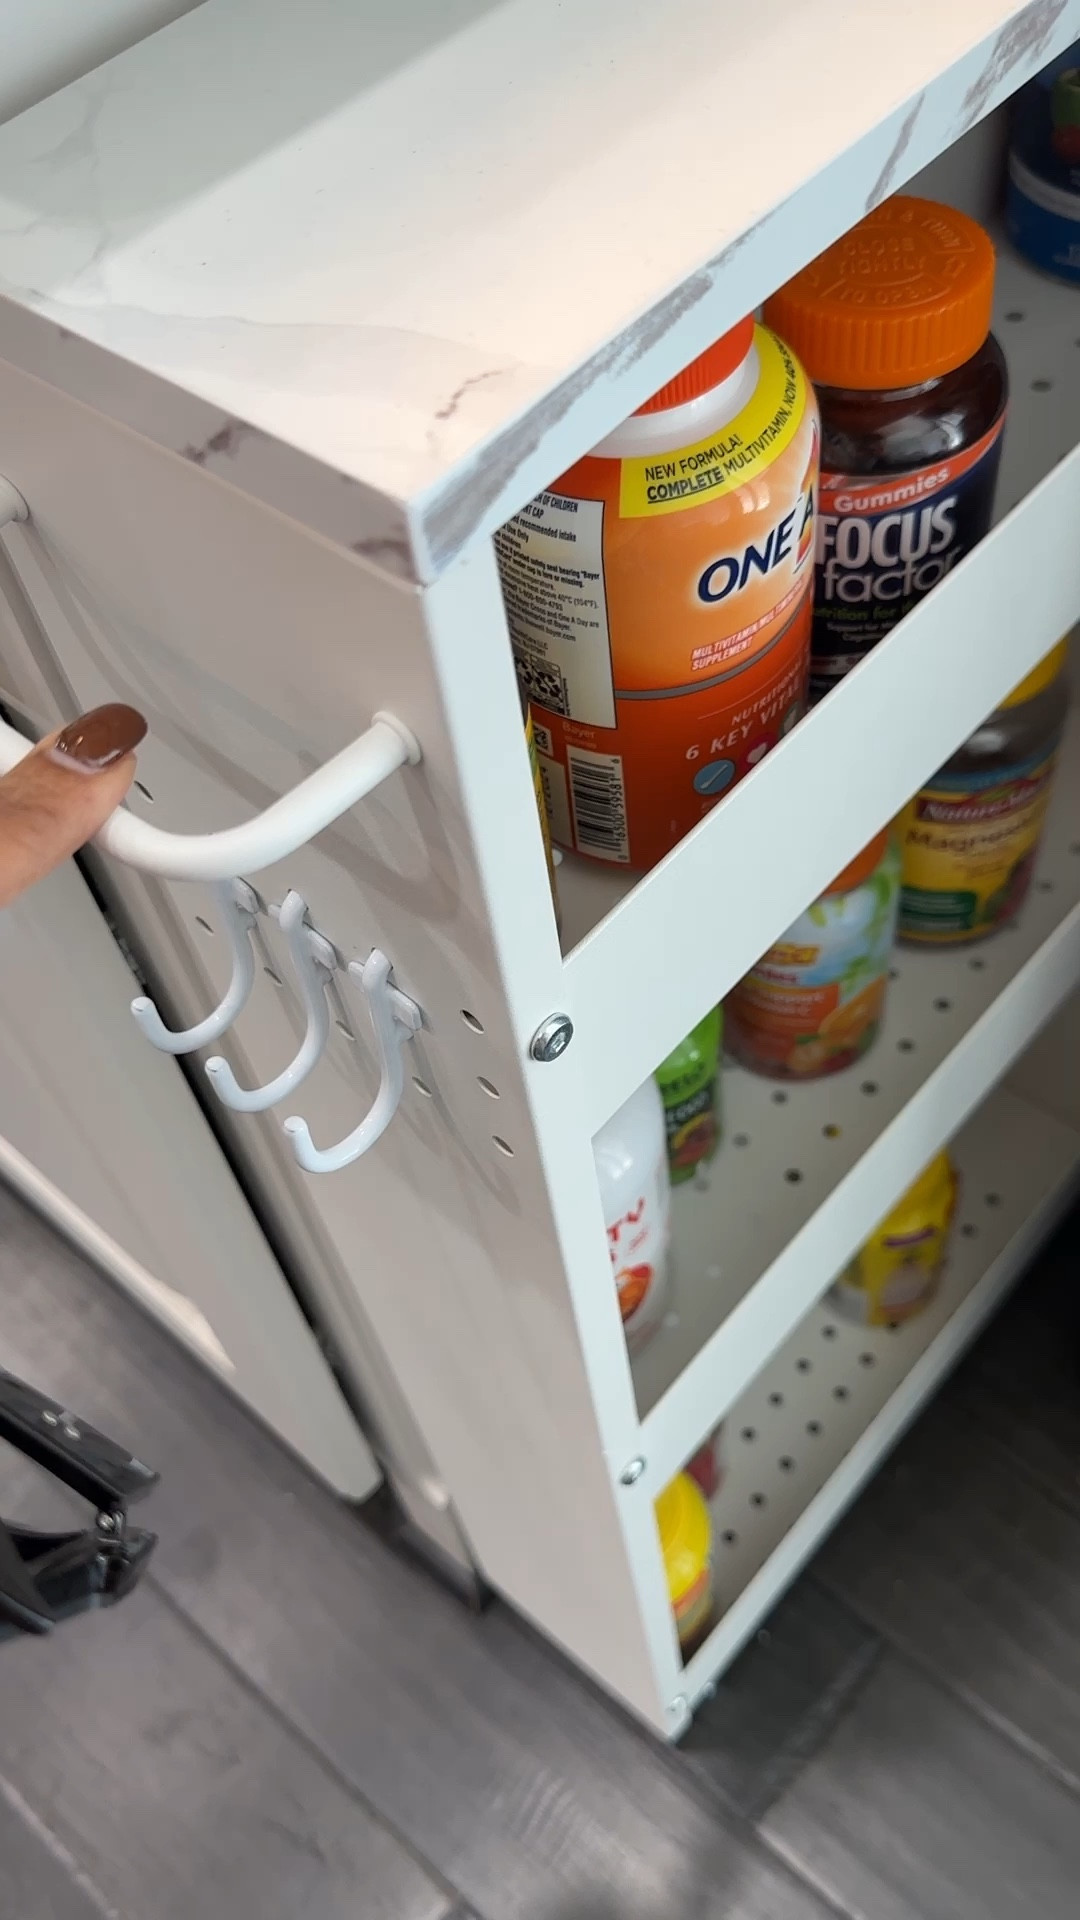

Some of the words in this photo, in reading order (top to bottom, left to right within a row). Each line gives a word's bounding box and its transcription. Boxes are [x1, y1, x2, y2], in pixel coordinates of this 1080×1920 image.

[842, 237, 916, 257] CLOSE
[838, 255, 927, 275] TIGHTLY
[840, 288, 866, 304] TO
[647, 467, 725, 502] COMPLETE
[723, 405, 793, 476] MULTIVITAMIN,
[783, 381, 797, 406] NOW
[645, 462, 676, 482] NEW
[679, 433, 743, 474] FORMULA!
[833, 468, 949, 513] Gummies
[532, 506, 545, 519] CAP
[542, 494, 551, 506] OF
[550, 497, 579, 513] CHILDREN
[506, 523, 516, 536] Use
[517, 527, 529, 543] Only
[520, 518, 558, 538] recommended
[558, 529, 577, 542] intake
[814, 494, 958, 570] FOCUS
[697, 506, 796, 604] ONE
[530, 558, 546, 570] safety
[546, 563, 558, 573] seal
[558, 566, 580, 579] bearing
[822, 546, 961, 603] factor
[560, 576, 583, 588] missing.
[539, 589, 557, 600] above
[558, 593, 573, 604] 40°C
[546, 610, 558, 619] and
[558, 613, 570, 623] One
[576, 617, 588, 628] Day
[813, 606, 869, 621] utrition
[691, 636, 754, 671] SUPPLEMENT
[562, 721, 597, 739] Bayer
[685, 744, 700, 760] 6
[710, 721, 753, 754] KEY
